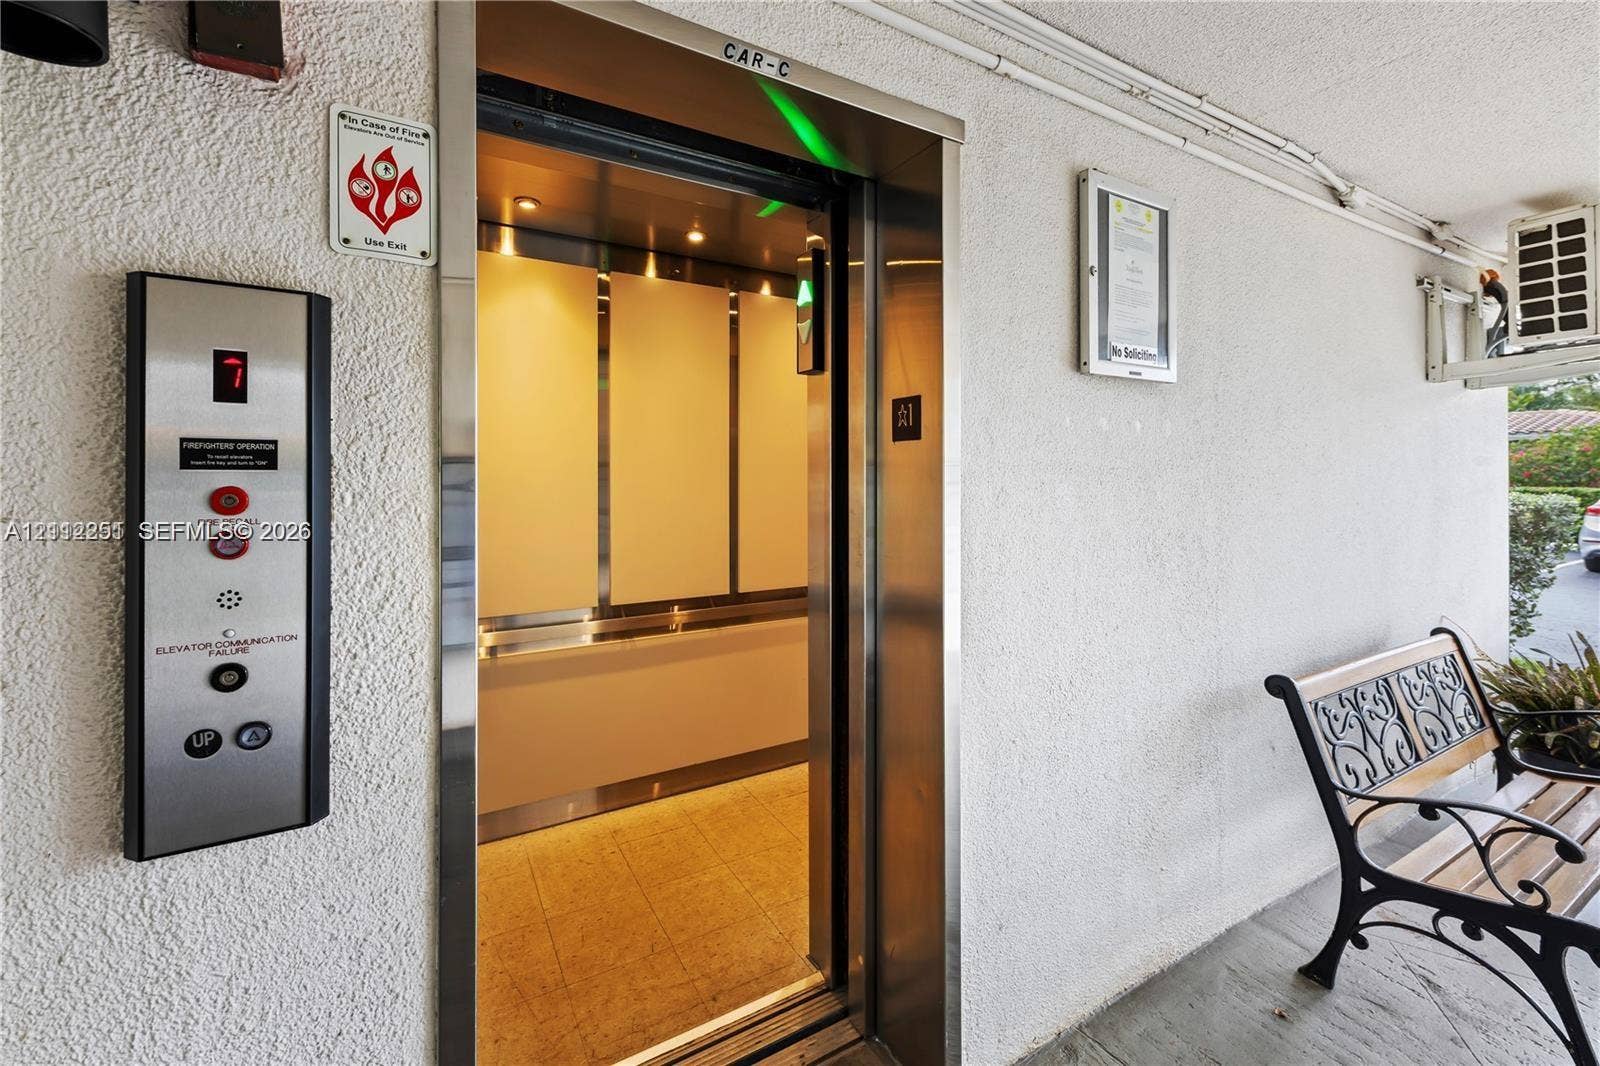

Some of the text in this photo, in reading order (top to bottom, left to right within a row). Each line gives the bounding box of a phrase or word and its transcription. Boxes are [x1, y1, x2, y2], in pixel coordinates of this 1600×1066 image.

[723, 42, 790, 78] CAR-C
[343, 124, 372, 135] Elevators
[403, 137, 425, 146] Service
[348, 115, 421, 139] In Case of Fire
[364, 236, 408, 251] Use Exit
[1111, 344, 1157, 365] No Soliciting
[236, 442, 275, 450] OPERATION
[155, 634, 298, 655] ELEVATOR COMMUNICATION
[208, 646, 250, 658] FAILURE
[192, 730, 215, 748] UP
